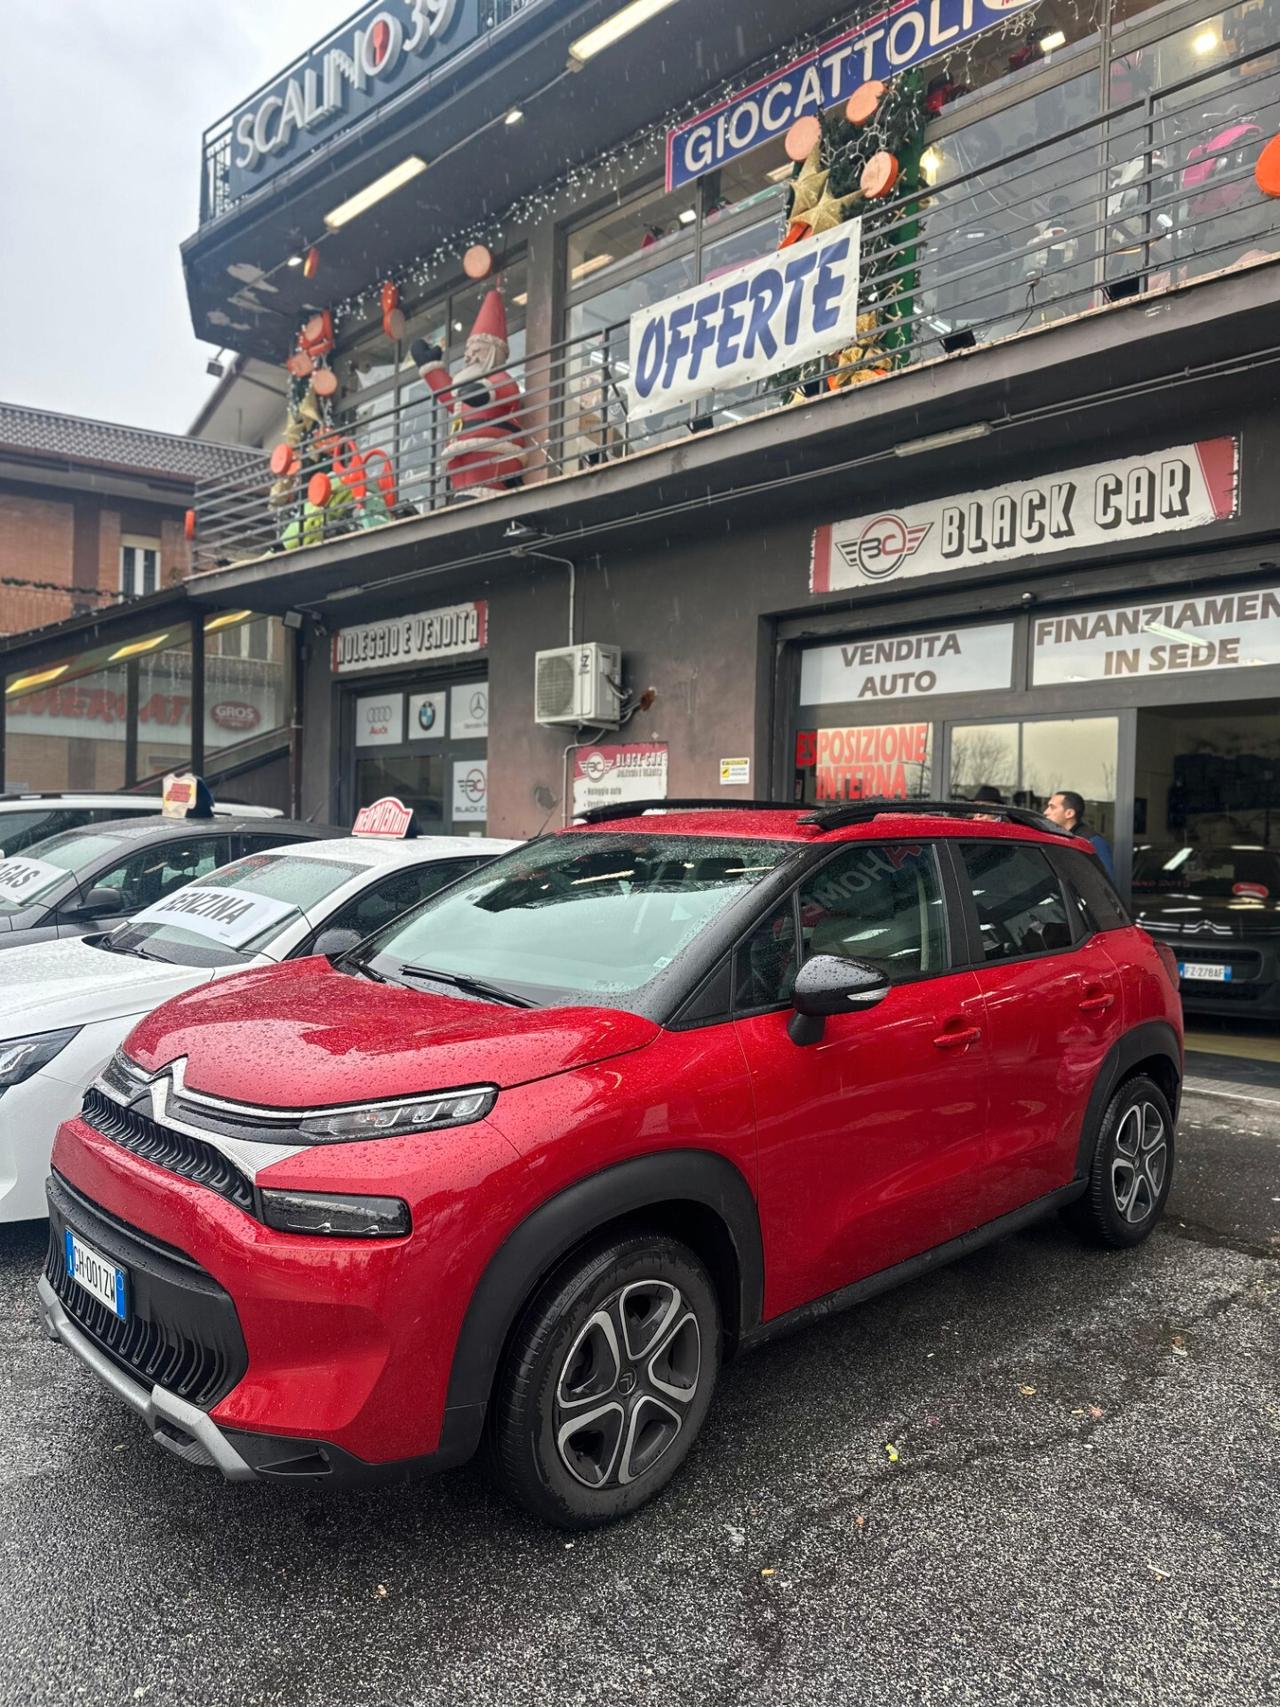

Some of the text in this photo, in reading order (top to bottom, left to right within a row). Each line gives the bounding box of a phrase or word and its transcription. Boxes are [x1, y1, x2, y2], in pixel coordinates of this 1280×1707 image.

[236, 12, 402, 170] SCALINO
[635, 237, 850, 398] OFFERTE
[941, 481, 1078, 559] BLACK
[1094, 459, 1191, 529] CAR
[337, 609, 480, 664] NOLEGGIO E VENDITA
[1036, 592, 1280, 646] FINANZIAMEN
[840, 633, 962, 668] VENDITA
[1104, 638, 1241, 676] IN SEDE
[858, 670, 937, 699] AUTO
[215, 704, 255, 719] GROS
[796, 725, 929, 768] ESPOSIZIONE
[816, 763, 908, 800] INTERNA
[156, 893, 255, 925] BENZINA
